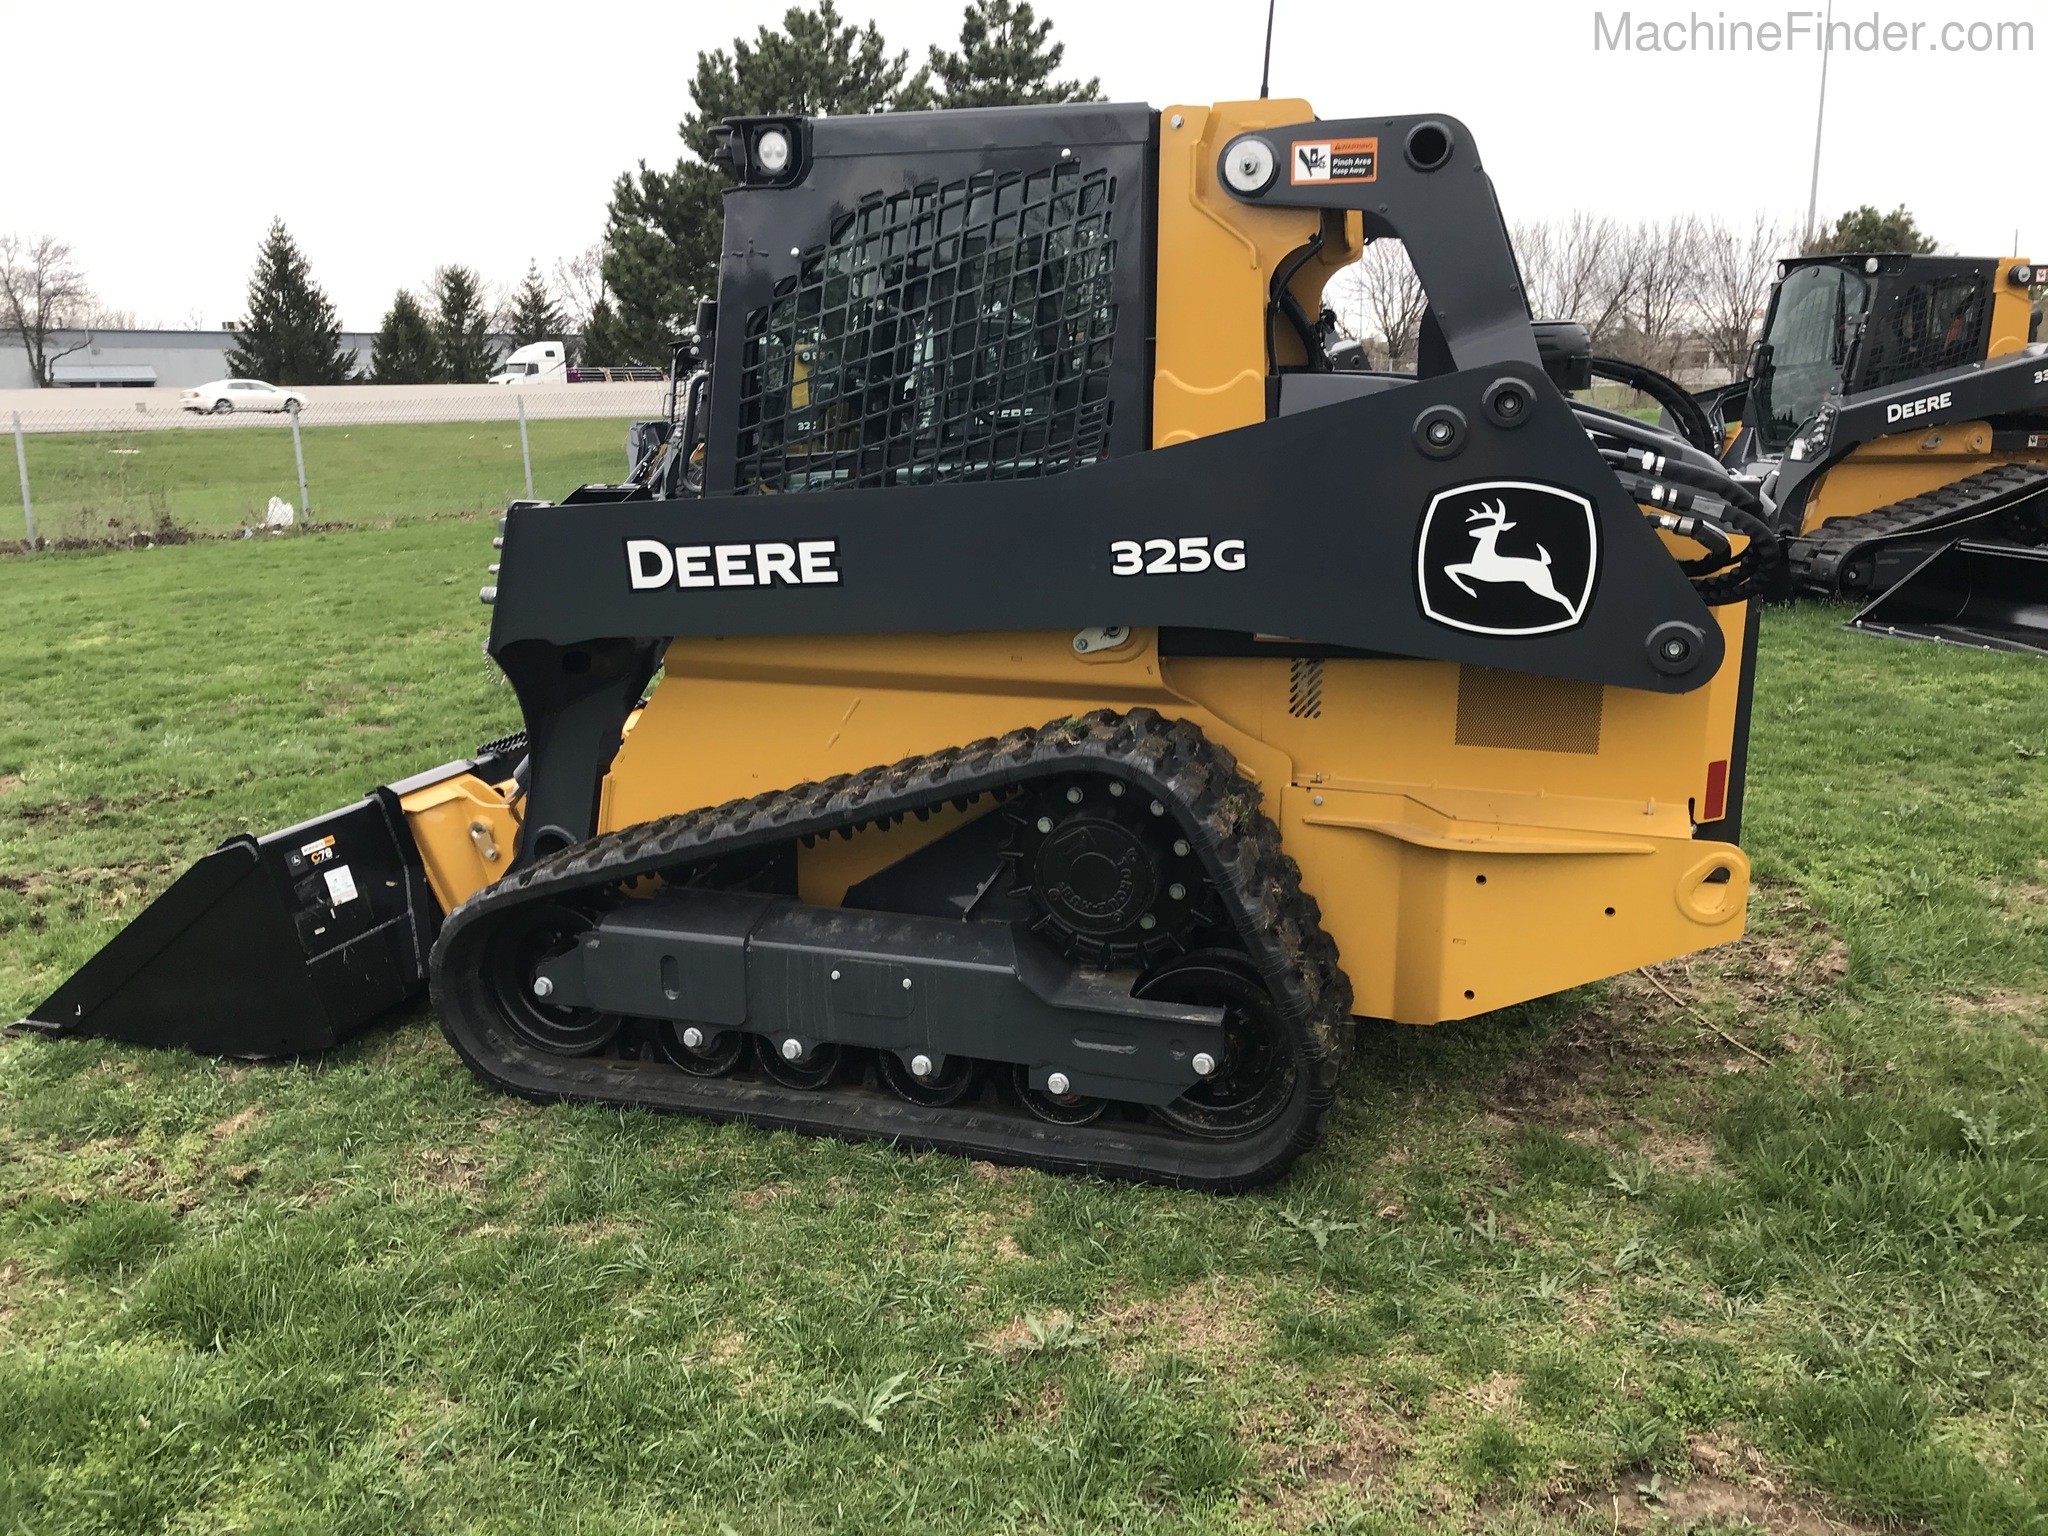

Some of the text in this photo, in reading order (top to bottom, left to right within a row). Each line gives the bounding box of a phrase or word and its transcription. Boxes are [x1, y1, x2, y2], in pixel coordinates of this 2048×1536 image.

[1332, 157, 1372, 167] Pinch Area
[1332, 166, 1366, 176] Keep Away
[1887, 391, 1952, 423] DEERE
[626, 539, 839, 589] DEERE
[1110, 536, 1247, 575] 325G
[311, 847, 333, 864] C78
